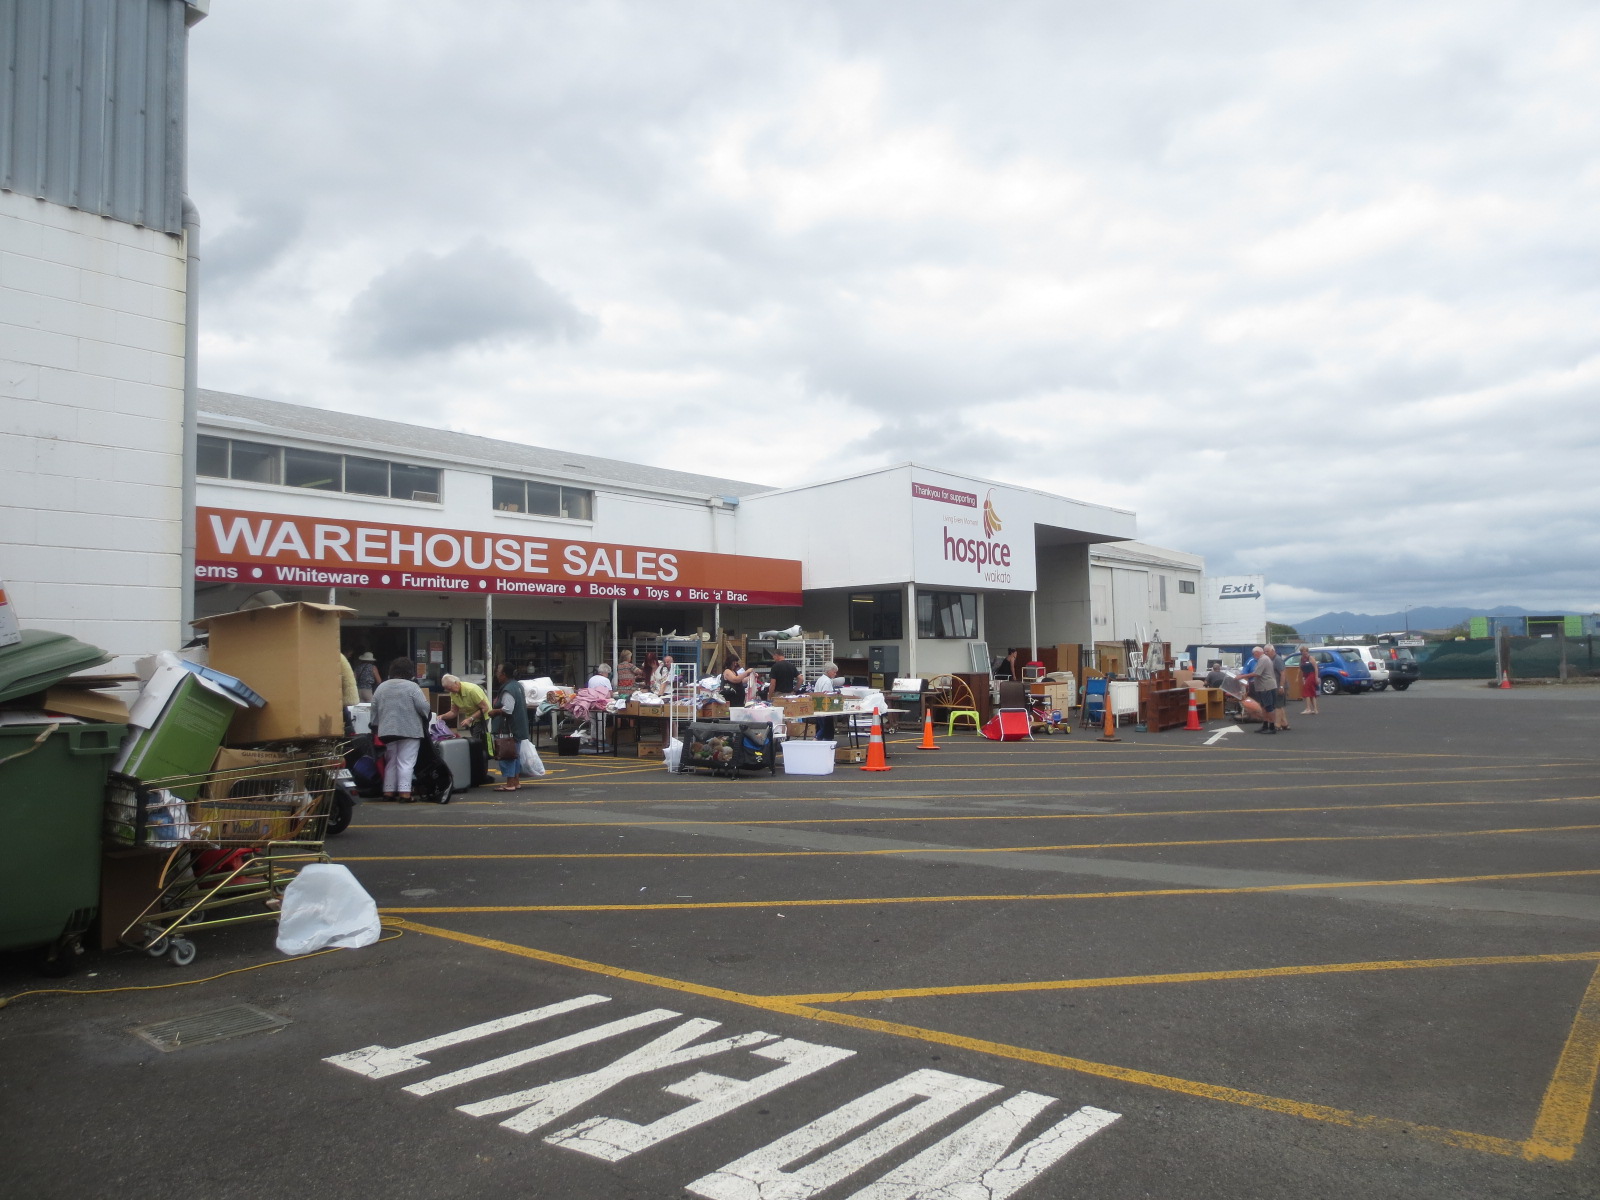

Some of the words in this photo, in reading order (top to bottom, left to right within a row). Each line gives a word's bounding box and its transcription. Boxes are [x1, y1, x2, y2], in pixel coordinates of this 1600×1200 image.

[914, 484, 940, 498] Thankyou
[941, 490, 949, 499] for
[950, 493, 976, 507] supporting
[209, 514, 549, 574] WAREHOUSE
[563, 544, 679, 582] SALES
[944, 526, 1010, 573] hospice
[195, 564, 238, 579] ems
[276, 566, 369, 585] Whiteware
[402, 573, 469, 589] Furniture
[496, 578, 566, 593] Homeware
[589, 583, 626, 596] Books
[646, 586, 669, 600] Toys
[689, 589, 709, 600] Bric
[727, 591, 747, 602] Brac
[984, 570, 1011, 583] waikato
[1221, 583, 1255, 593] Exit
[322, 994, 857, 1162] EXIT
